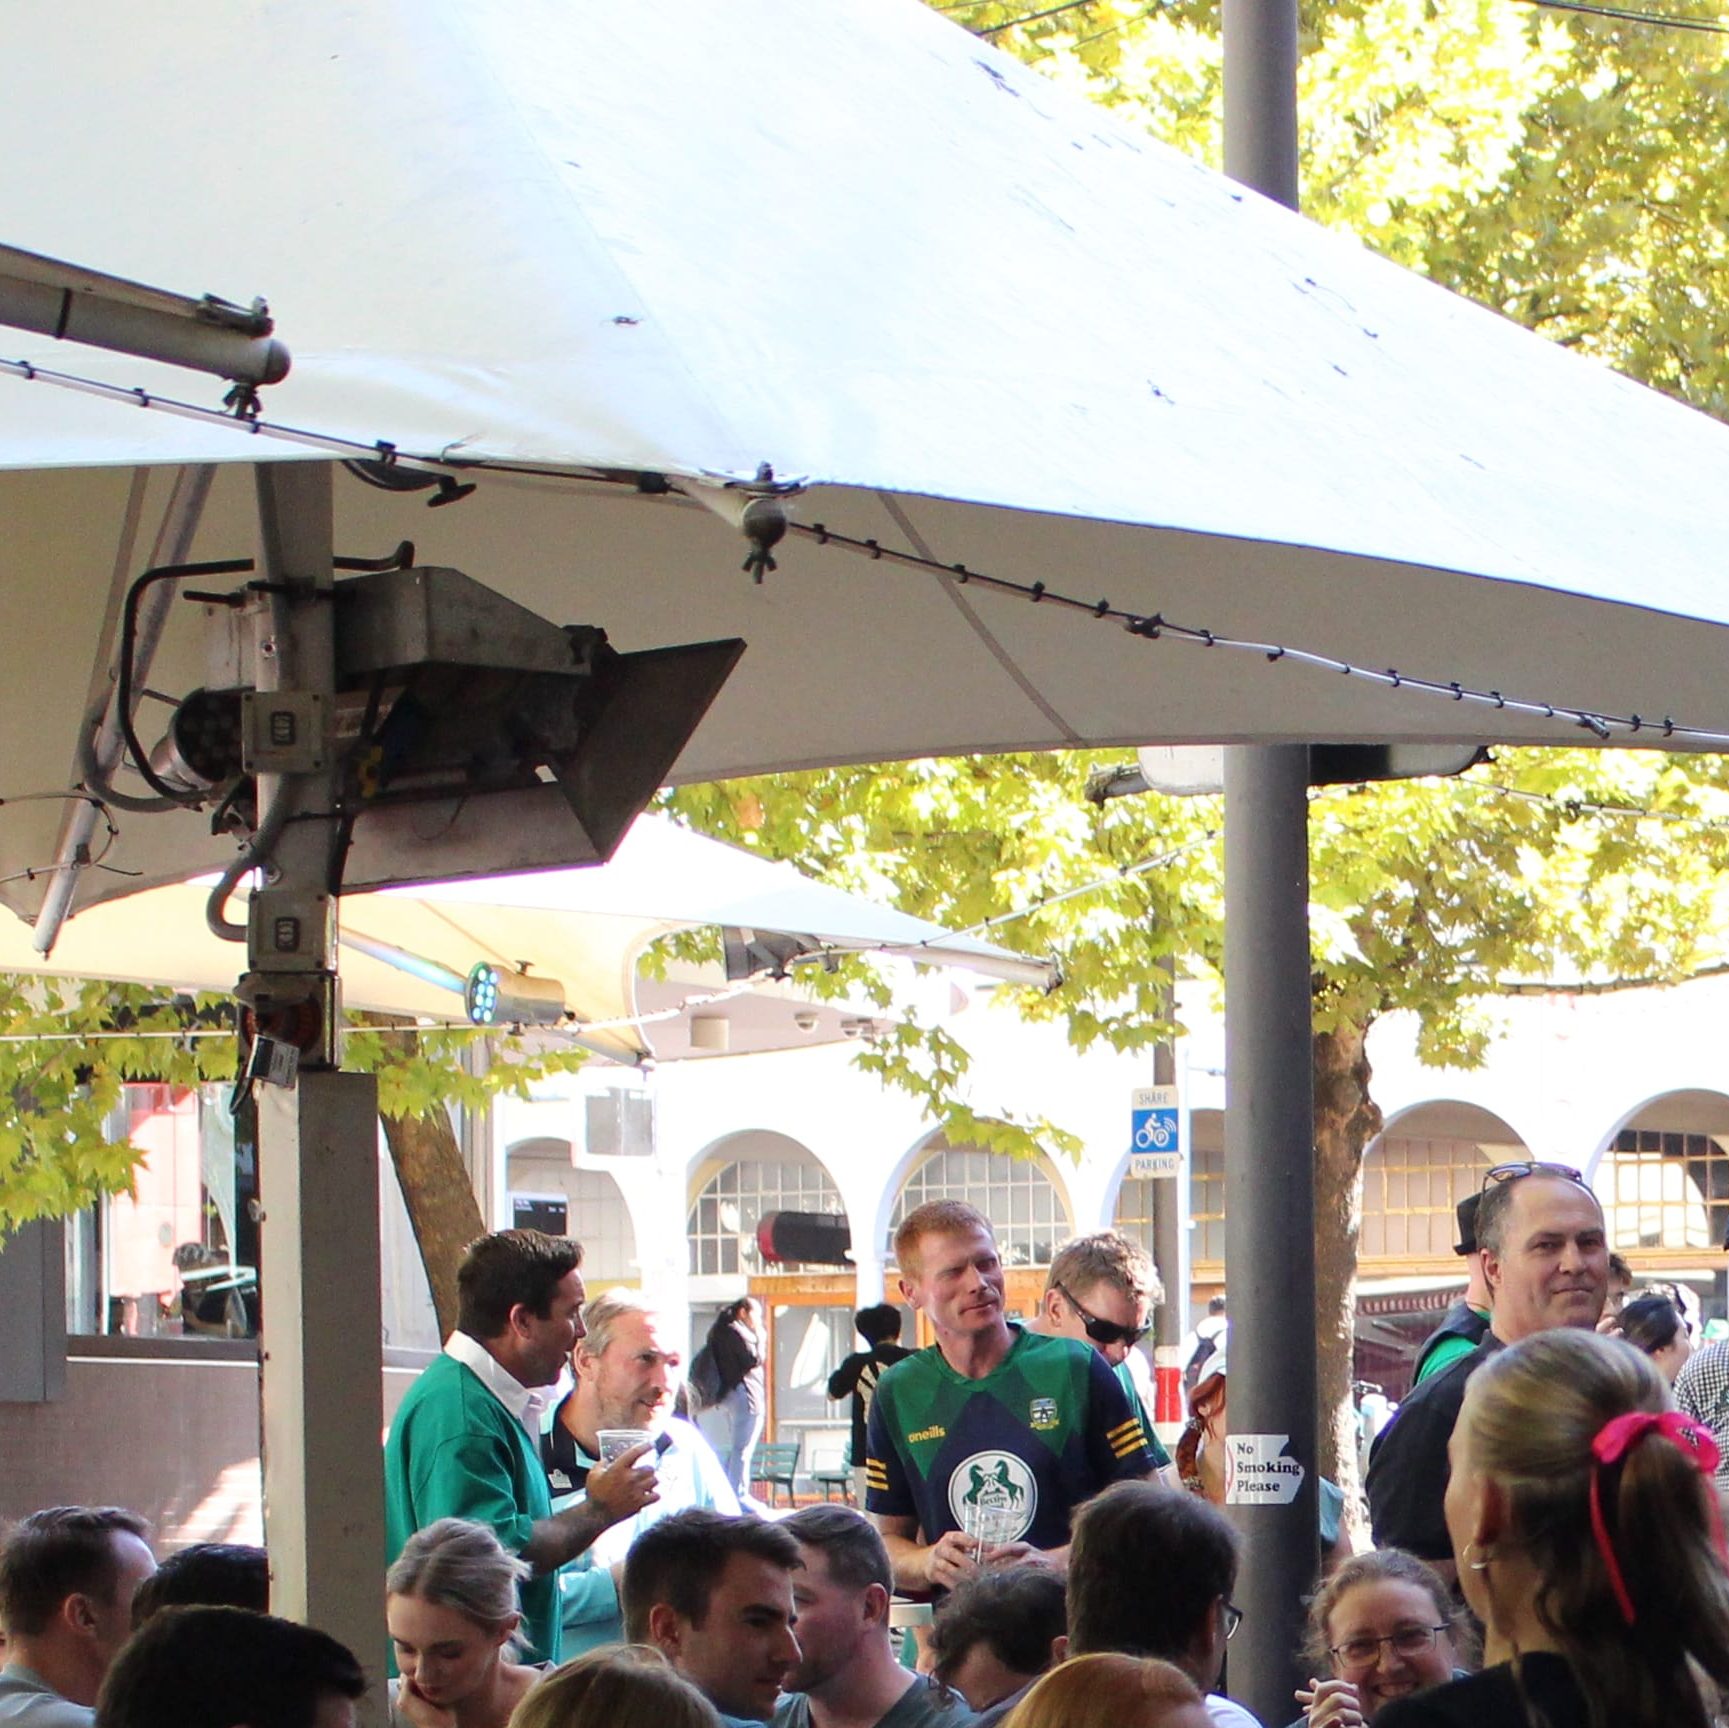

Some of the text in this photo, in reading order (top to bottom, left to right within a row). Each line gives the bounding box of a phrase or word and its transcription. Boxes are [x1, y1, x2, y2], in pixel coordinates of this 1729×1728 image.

[1139, 1092, 1169, 1105] SHARE
[1135, 1158, 1175, 1169] PARKING
[908, 1424, 946, 1443] oneills
[1237, 1442, 1254, 1455] No
[1237, 1461, 1300, 1476] Smoking
[1237, 1480, 1281, 1492] Please
